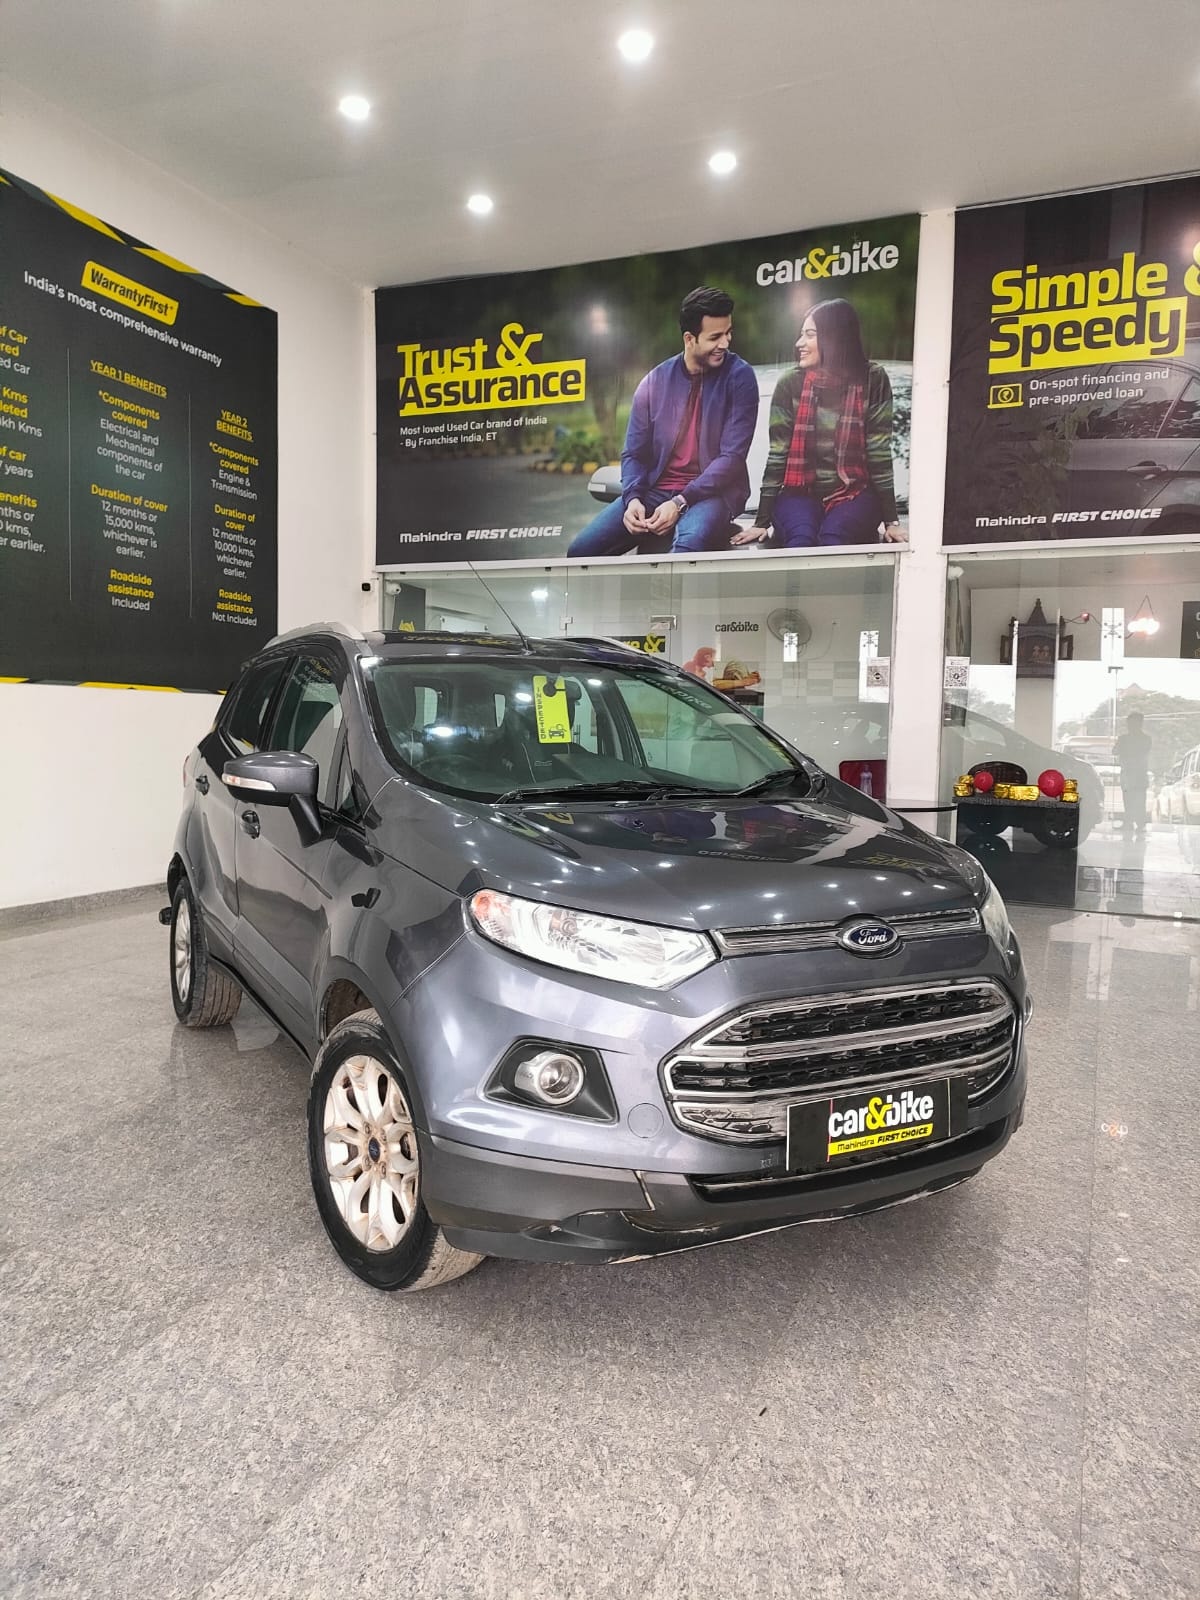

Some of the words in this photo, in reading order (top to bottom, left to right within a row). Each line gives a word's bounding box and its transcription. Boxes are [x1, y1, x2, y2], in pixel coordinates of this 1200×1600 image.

[756, 241, 899, 286] car&bike
[991, 252, 1168, 314] Simple
[24, 271, 65, 298] India's
[67, 291, 97, 313] most
[99, 304, 179, 347] comprehensive
[180, 341, 222, 368] warranty
[8, 329, 28, 344] Car
[990, 302, 1181, 367] Speedy
[397, 338, 488, 377] Trust
[496, 322, 543, 369] &
[13, 362, 31, 375] car
[90, 360, 116, 378] YEAR
[124, 373, 168, 398] BENEFITS
[1029, 376, 1079, 390] On-spot
[1082, 371, 1141, 385] financing
[1144, 368, 1169, 380] and
[2, 387, 29, 404] Kms
[400, 369, 581, 410] Assurance
[1029, 388, 1112, 408] pre-approved
[1116, 387, 1143, 398] loan
[112, 411, 148, 429] covered
[221, 409, 242, 424] YEAR
[242, 418, 248, 428] 2
[400, 427, 420, 436] Most
[422, 424, 445, 434] loved
[446, 422, 468, 432] Used
[470, 421, 485, 431] Car
[486, 419, 511, 429] brand
[513, 417, 523, 427] of
[525, 416, 548, 426] India
[18, 421, 42, 437] Kms
[100, 418, 141, 439] Electrical
[142, 433, 159, 446] and
[216, 420, 254, 441] BENEFITS
[105, 433, 155, 457] Mechanical
[405, 438, 417, 448] By
[418, 435, 459, 446] Franchise
[460, 433, 484, 444] India,
[486, 432, 497, 441] ET
[8, 450, 27, 462] car
[97, 446, 153, 470] components
[154, 463, 163, 472] of
[4, 464, 34, 478] years
[115, 464, 130, 476] the
[131, 470, 146, 480] car
[220, 460, 249, 475] covered
[219, 469, 244, 485] Engine
[245, 478, 251, 486] &
[91, 484, 131, 503] Duration
[133, 496, 142, 506] of
[144, 499, 168, 512] cover
[211, 479, 258, 500] Transmission
[23, 512, 35, 522] or
[101, 500, 111, 512] 12
[112, 504, 147, 520] months
[148, 514, 158, 523] or
[214, 504, 246, 520] Duration
[248, 514, 256, 523] of
[976, 515, 1047, 527] Mahindra
[1052, 511, 1100, 523] FIRST
[1100, 508, 1162, 521] CHOICE
[5, 521, 31, 537] kms,
[104, 515, 133, 530] 15,000
[134, 521, 156, 536] kms,
[224, 520, 245, 532] cover
[400, 531, 461, 543] Mahindra
[466, 528, 508, 540] FIRST
[508, 526, 562, 538] CHOICE
[10, 538, 46, 553] earlier.
[103, 529, 149, 546] whichever
[150, 538, 158, 548] is
[212, 527, 220, 538] 12
[220, 531, 248, 545] months
[249, 538, 257, 546] or
[116, 545, 146, 559] earlier.
[214, 540, 237, 553] 10,000
[238, 545, 255, 559] kms,
[216, 554, 253, 568] whichever
[110, 569, 153, 585] Roadside
[223, 567, 247, 579] earlier.
[107, 583, 155, 598] assistance
[219, 589, 252, 602] Roadside
[111, 596, 150, 611] Included
[216, 601, 254, 614] assistance
[212, 612, 226, 622] Not
[227, 614, 258, 626] Included
[715, 621, 759, 632] car&bike
[858, 928, 887, 945] Ford
[828, 1091, 934, 1138] car&bike
[837, 1137, 875, 1152] Mahindra
[877, 1132, 900, 1144] FIRST
[901, 1126, 928, 1139] CHOICE
